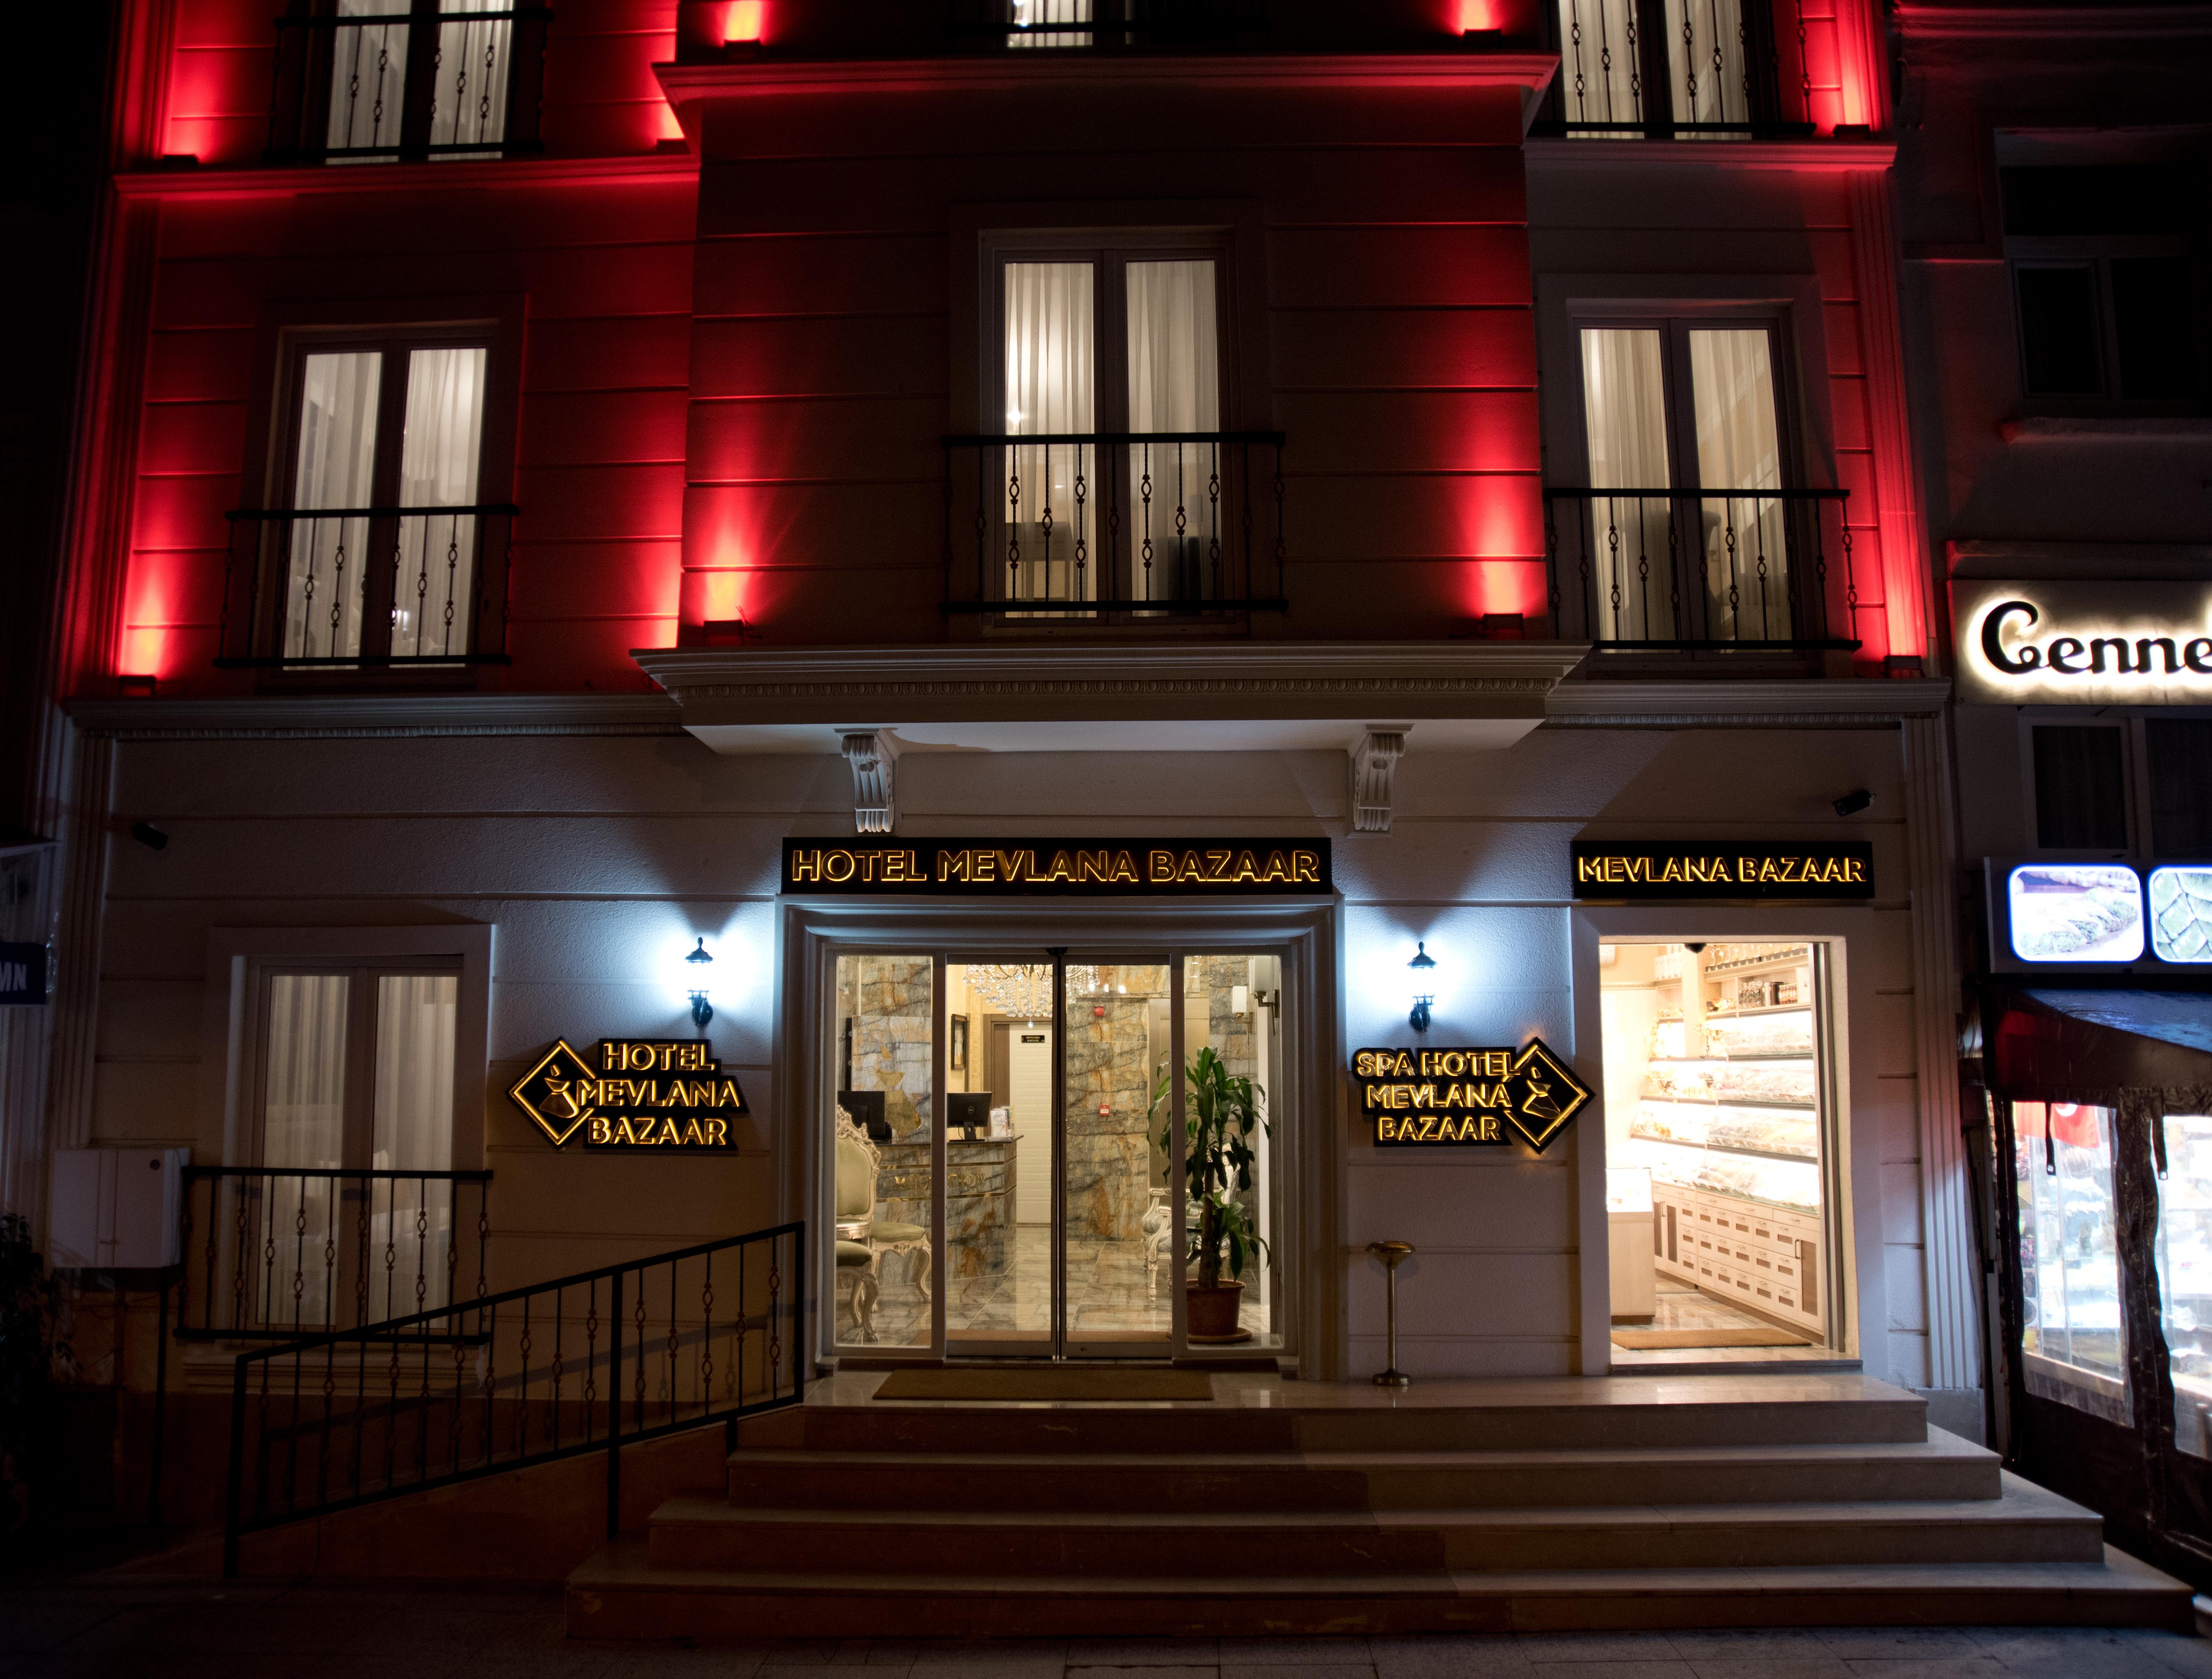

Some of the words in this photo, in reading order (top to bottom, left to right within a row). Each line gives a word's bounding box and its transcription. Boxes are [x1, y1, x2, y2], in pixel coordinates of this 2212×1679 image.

[793, 850, 927, 881] HOTEL
[938, 850, 1139, 882] MEVLANA
[1151, 850, 1320, 882] BAZAAR
[1579, 857, 1733, 882] MEVLANA
[1739, 857, 1867, 882] BAZAAR
[603, 1044, 716, 1071] HOTEL
[1357, 1052, 1414, 1077] SPA
[1423, 1052, 1520, 1076] HOTEL
[576, 1079, 740, 1107] MEVLANA
[1368, 1084, 1512, 1109] MEVLANA
[588, 1116, 727, 1145] BAZAAR
[1379, 1117, 1502, 1141] BAZAAR
